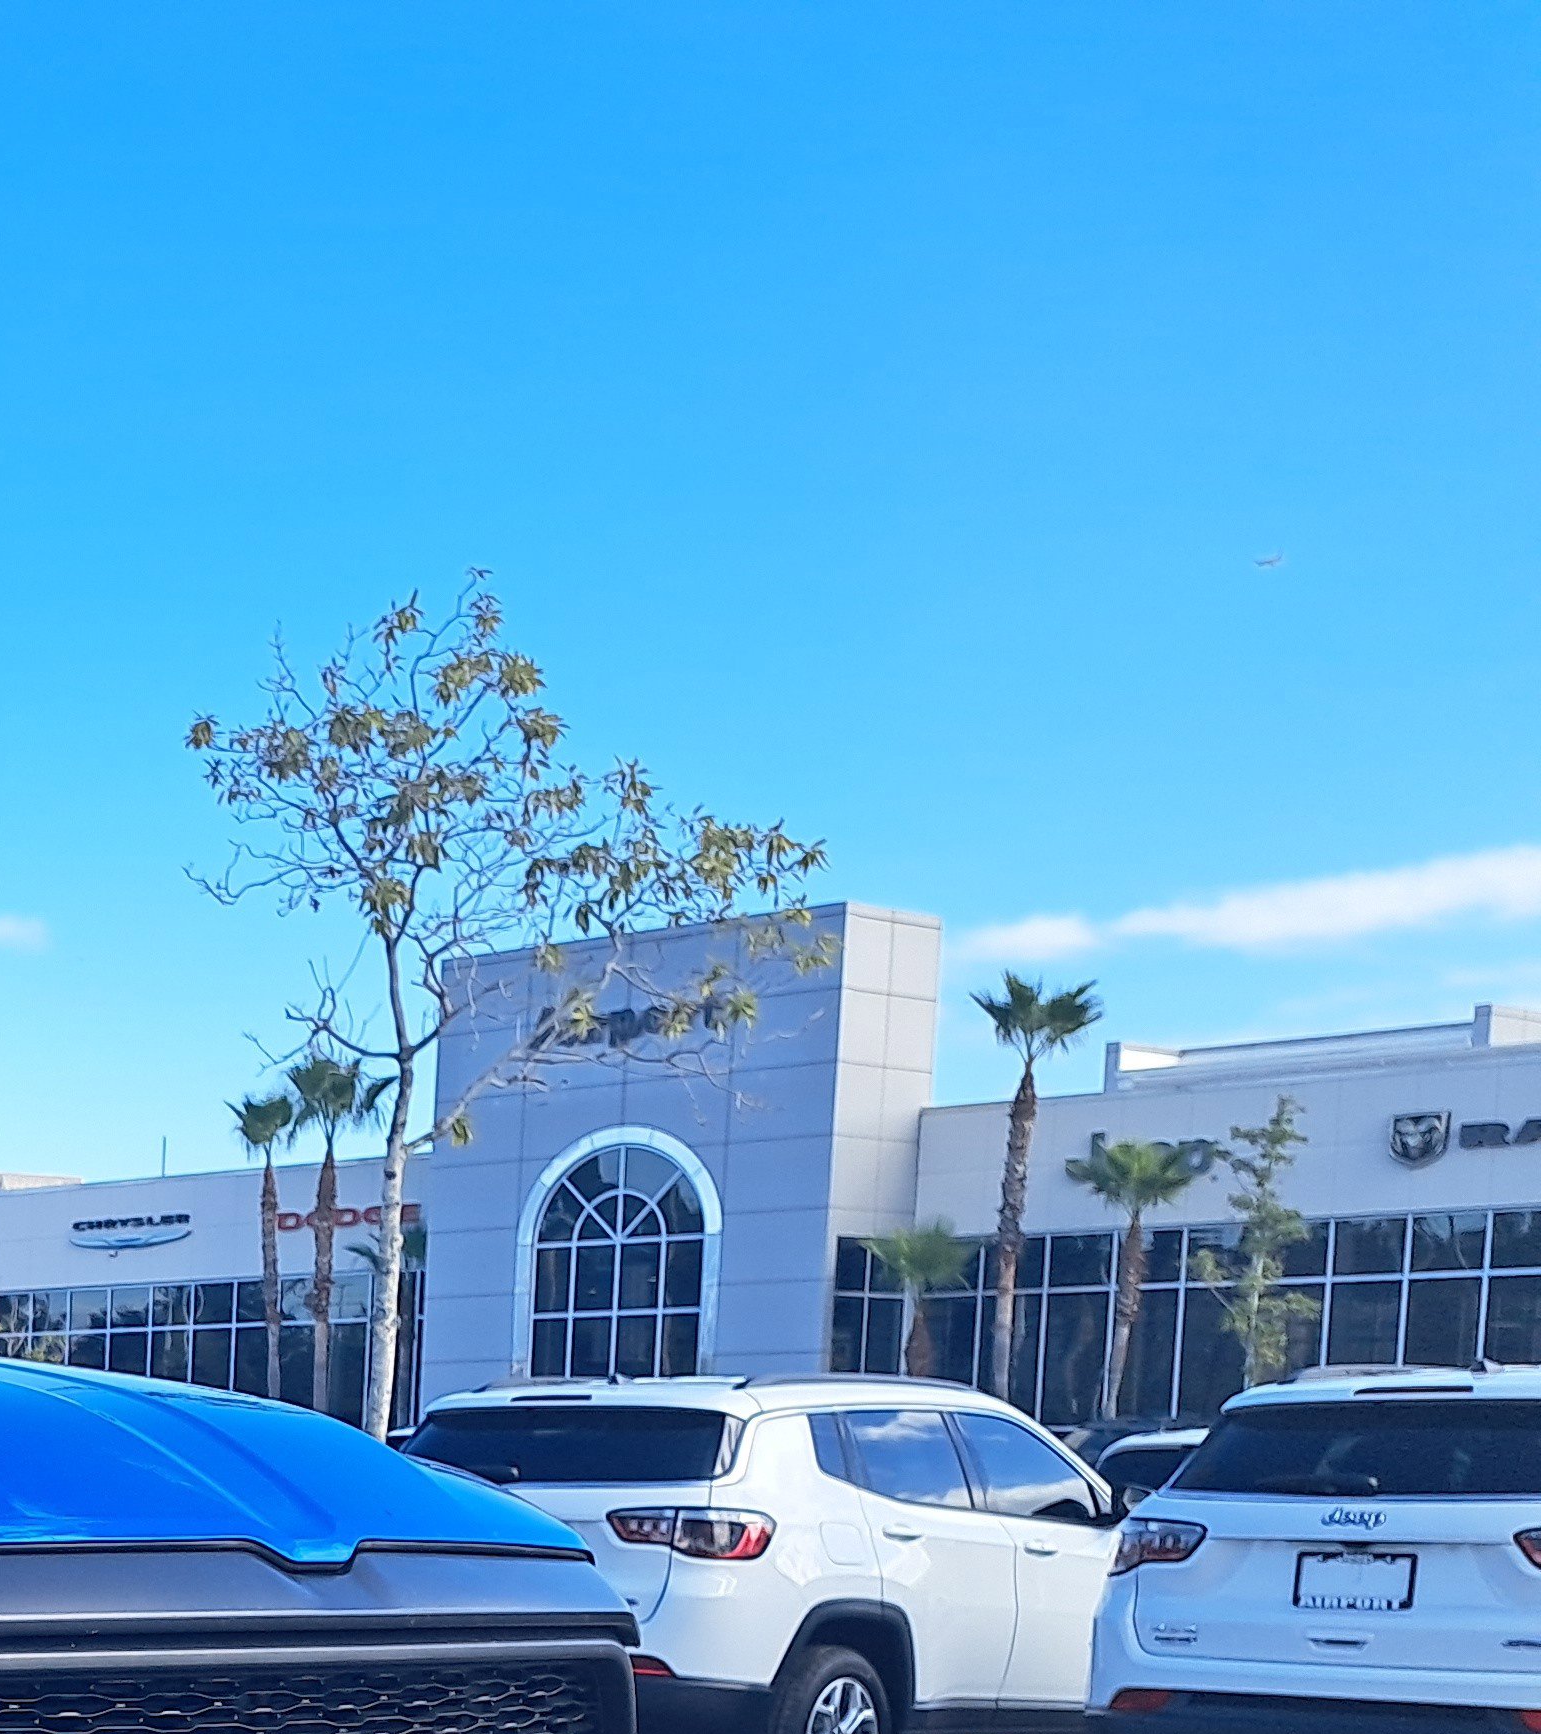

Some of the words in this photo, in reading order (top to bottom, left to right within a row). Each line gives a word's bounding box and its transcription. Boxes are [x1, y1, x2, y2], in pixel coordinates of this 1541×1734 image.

[72, 1214, 191, 1231] CHRYSLER
[1321, 1508, 1387, 1530] Jeep
[1299, 1597, 1400, 1610] AIRPORT
